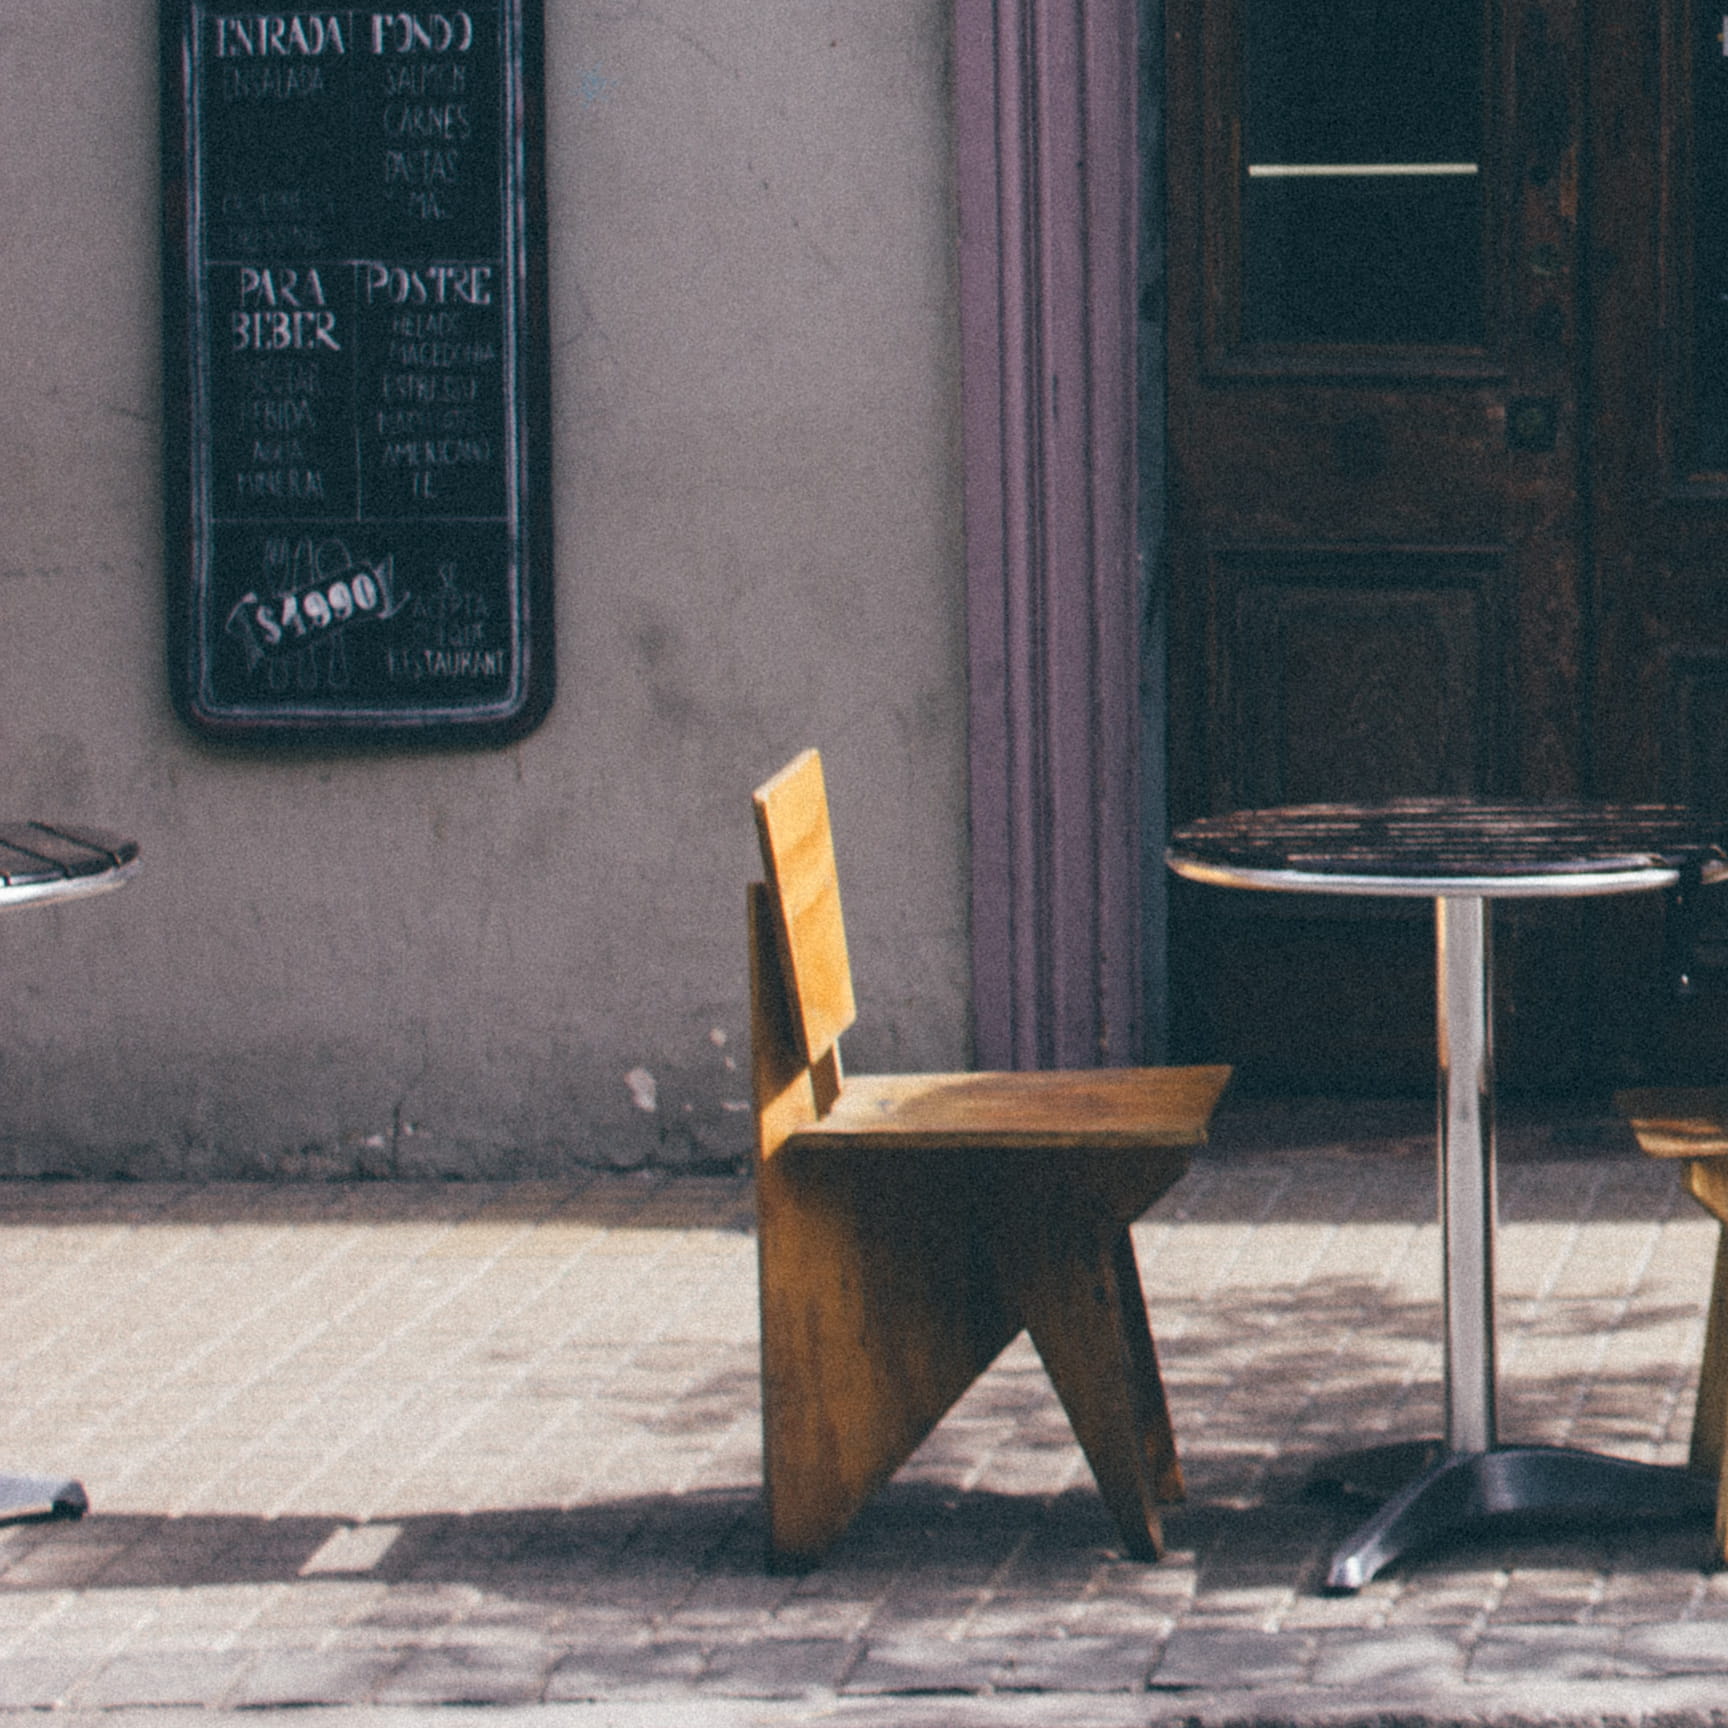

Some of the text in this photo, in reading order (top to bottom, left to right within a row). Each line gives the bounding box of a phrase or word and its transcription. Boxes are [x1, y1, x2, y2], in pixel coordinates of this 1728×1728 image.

[217, 13, 346, 57] ENTRADA
[372, 10, 474, 55] FONDO
[382, 103, 471, 140] CARNES
[239, 267, 326, 306] PARA
[366, 266, 492, 306] POSTRE
[232, 310, 342, 352] BEBER
